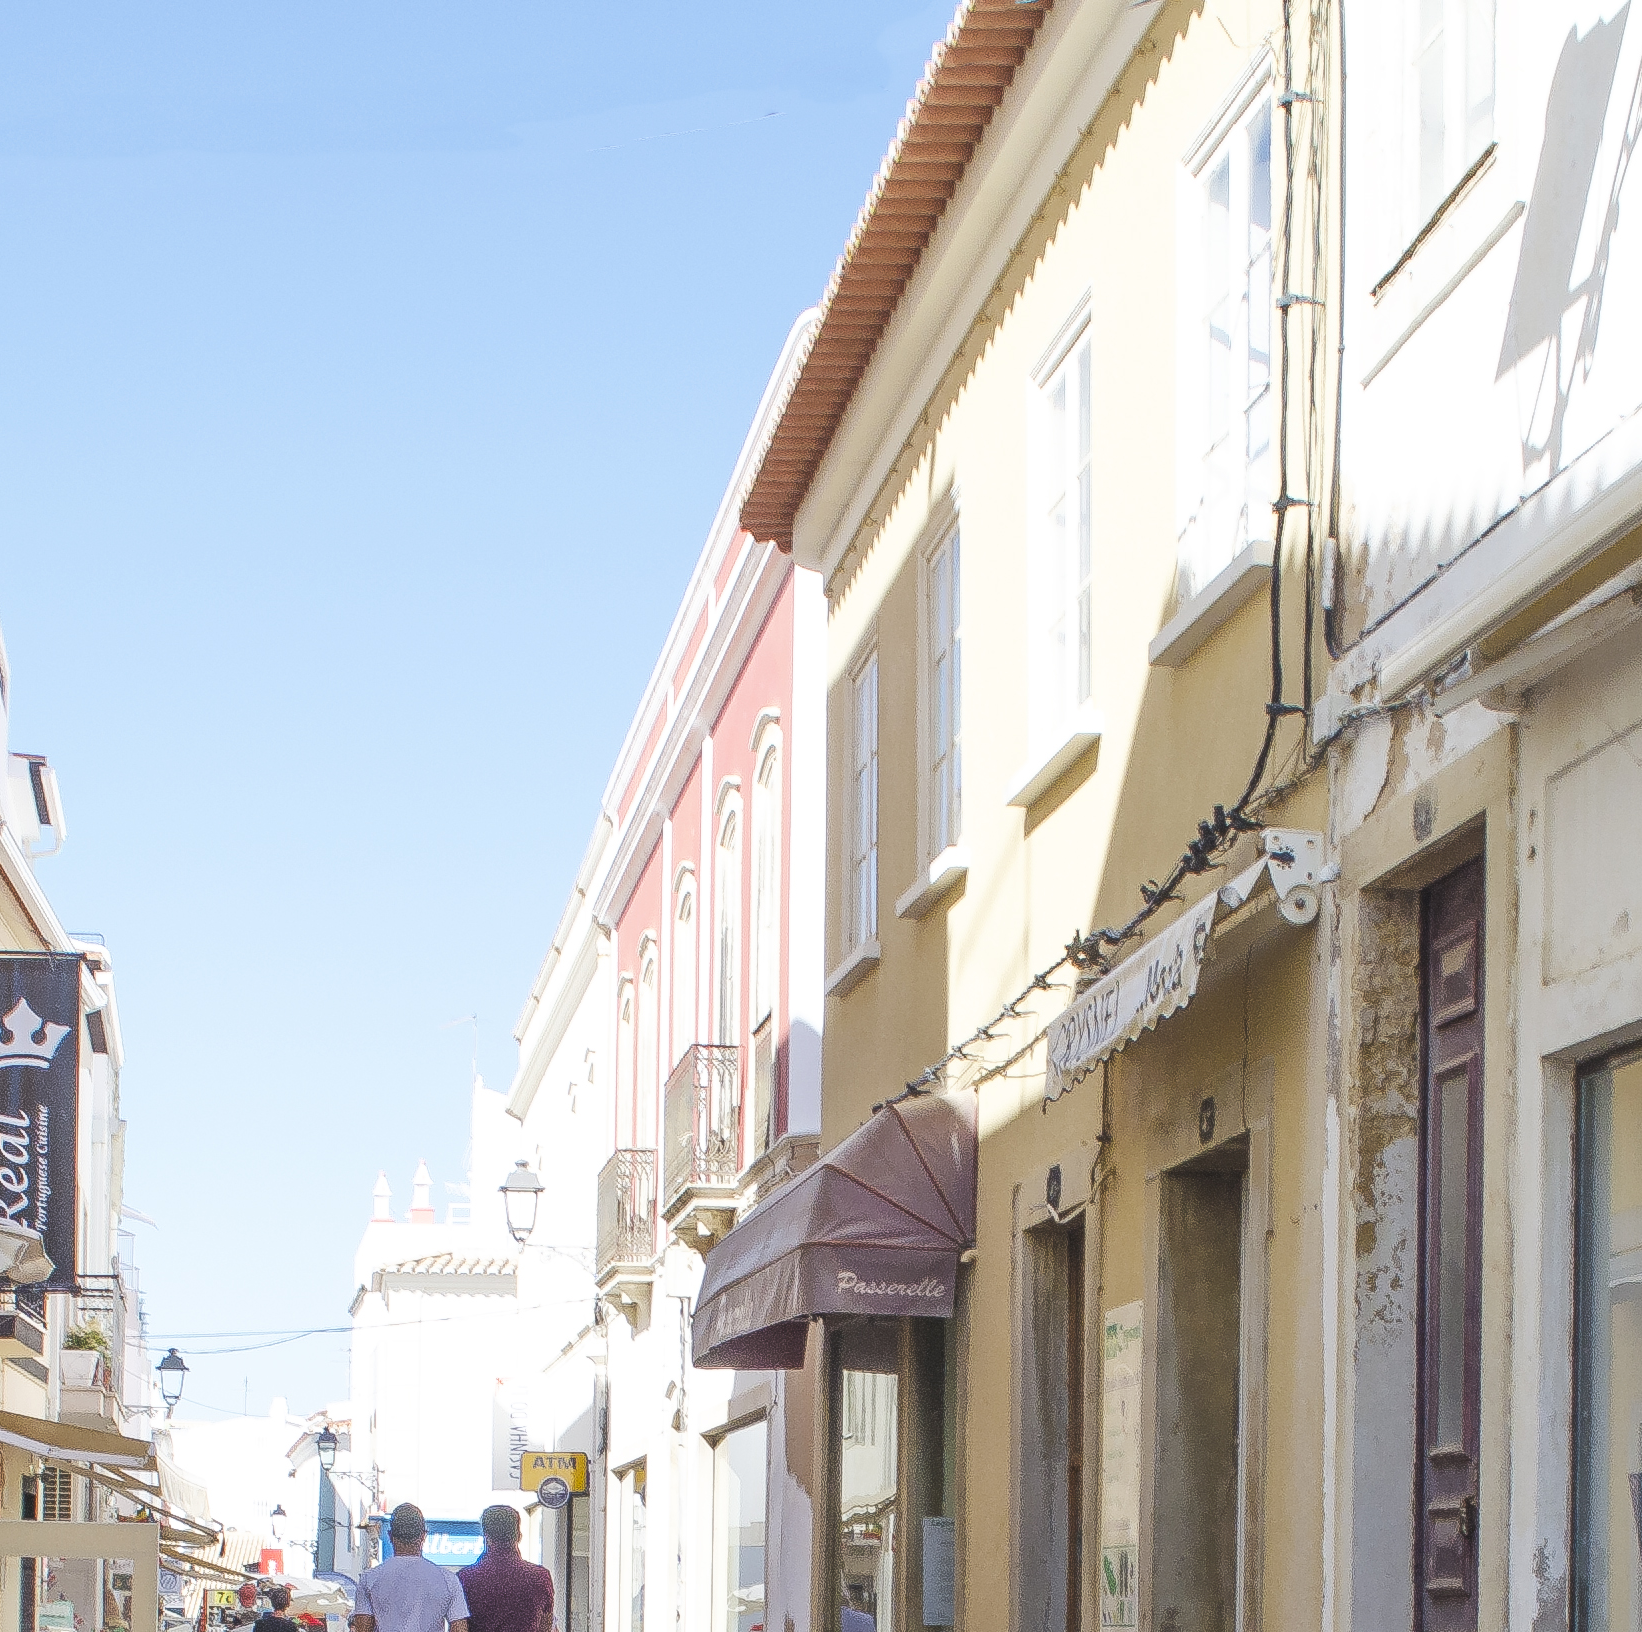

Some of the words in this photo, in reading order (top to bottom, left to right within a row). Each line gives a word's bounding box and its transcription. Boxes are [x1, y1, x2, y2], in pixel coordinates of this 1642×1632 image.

[35, 1103, 50, 1155] Cuisine
[35, 1156, 52, 1231] Portuguese
[837, 1271, 945, 1298] Passerelle
[532, 1457, 577, 1470] ATM
